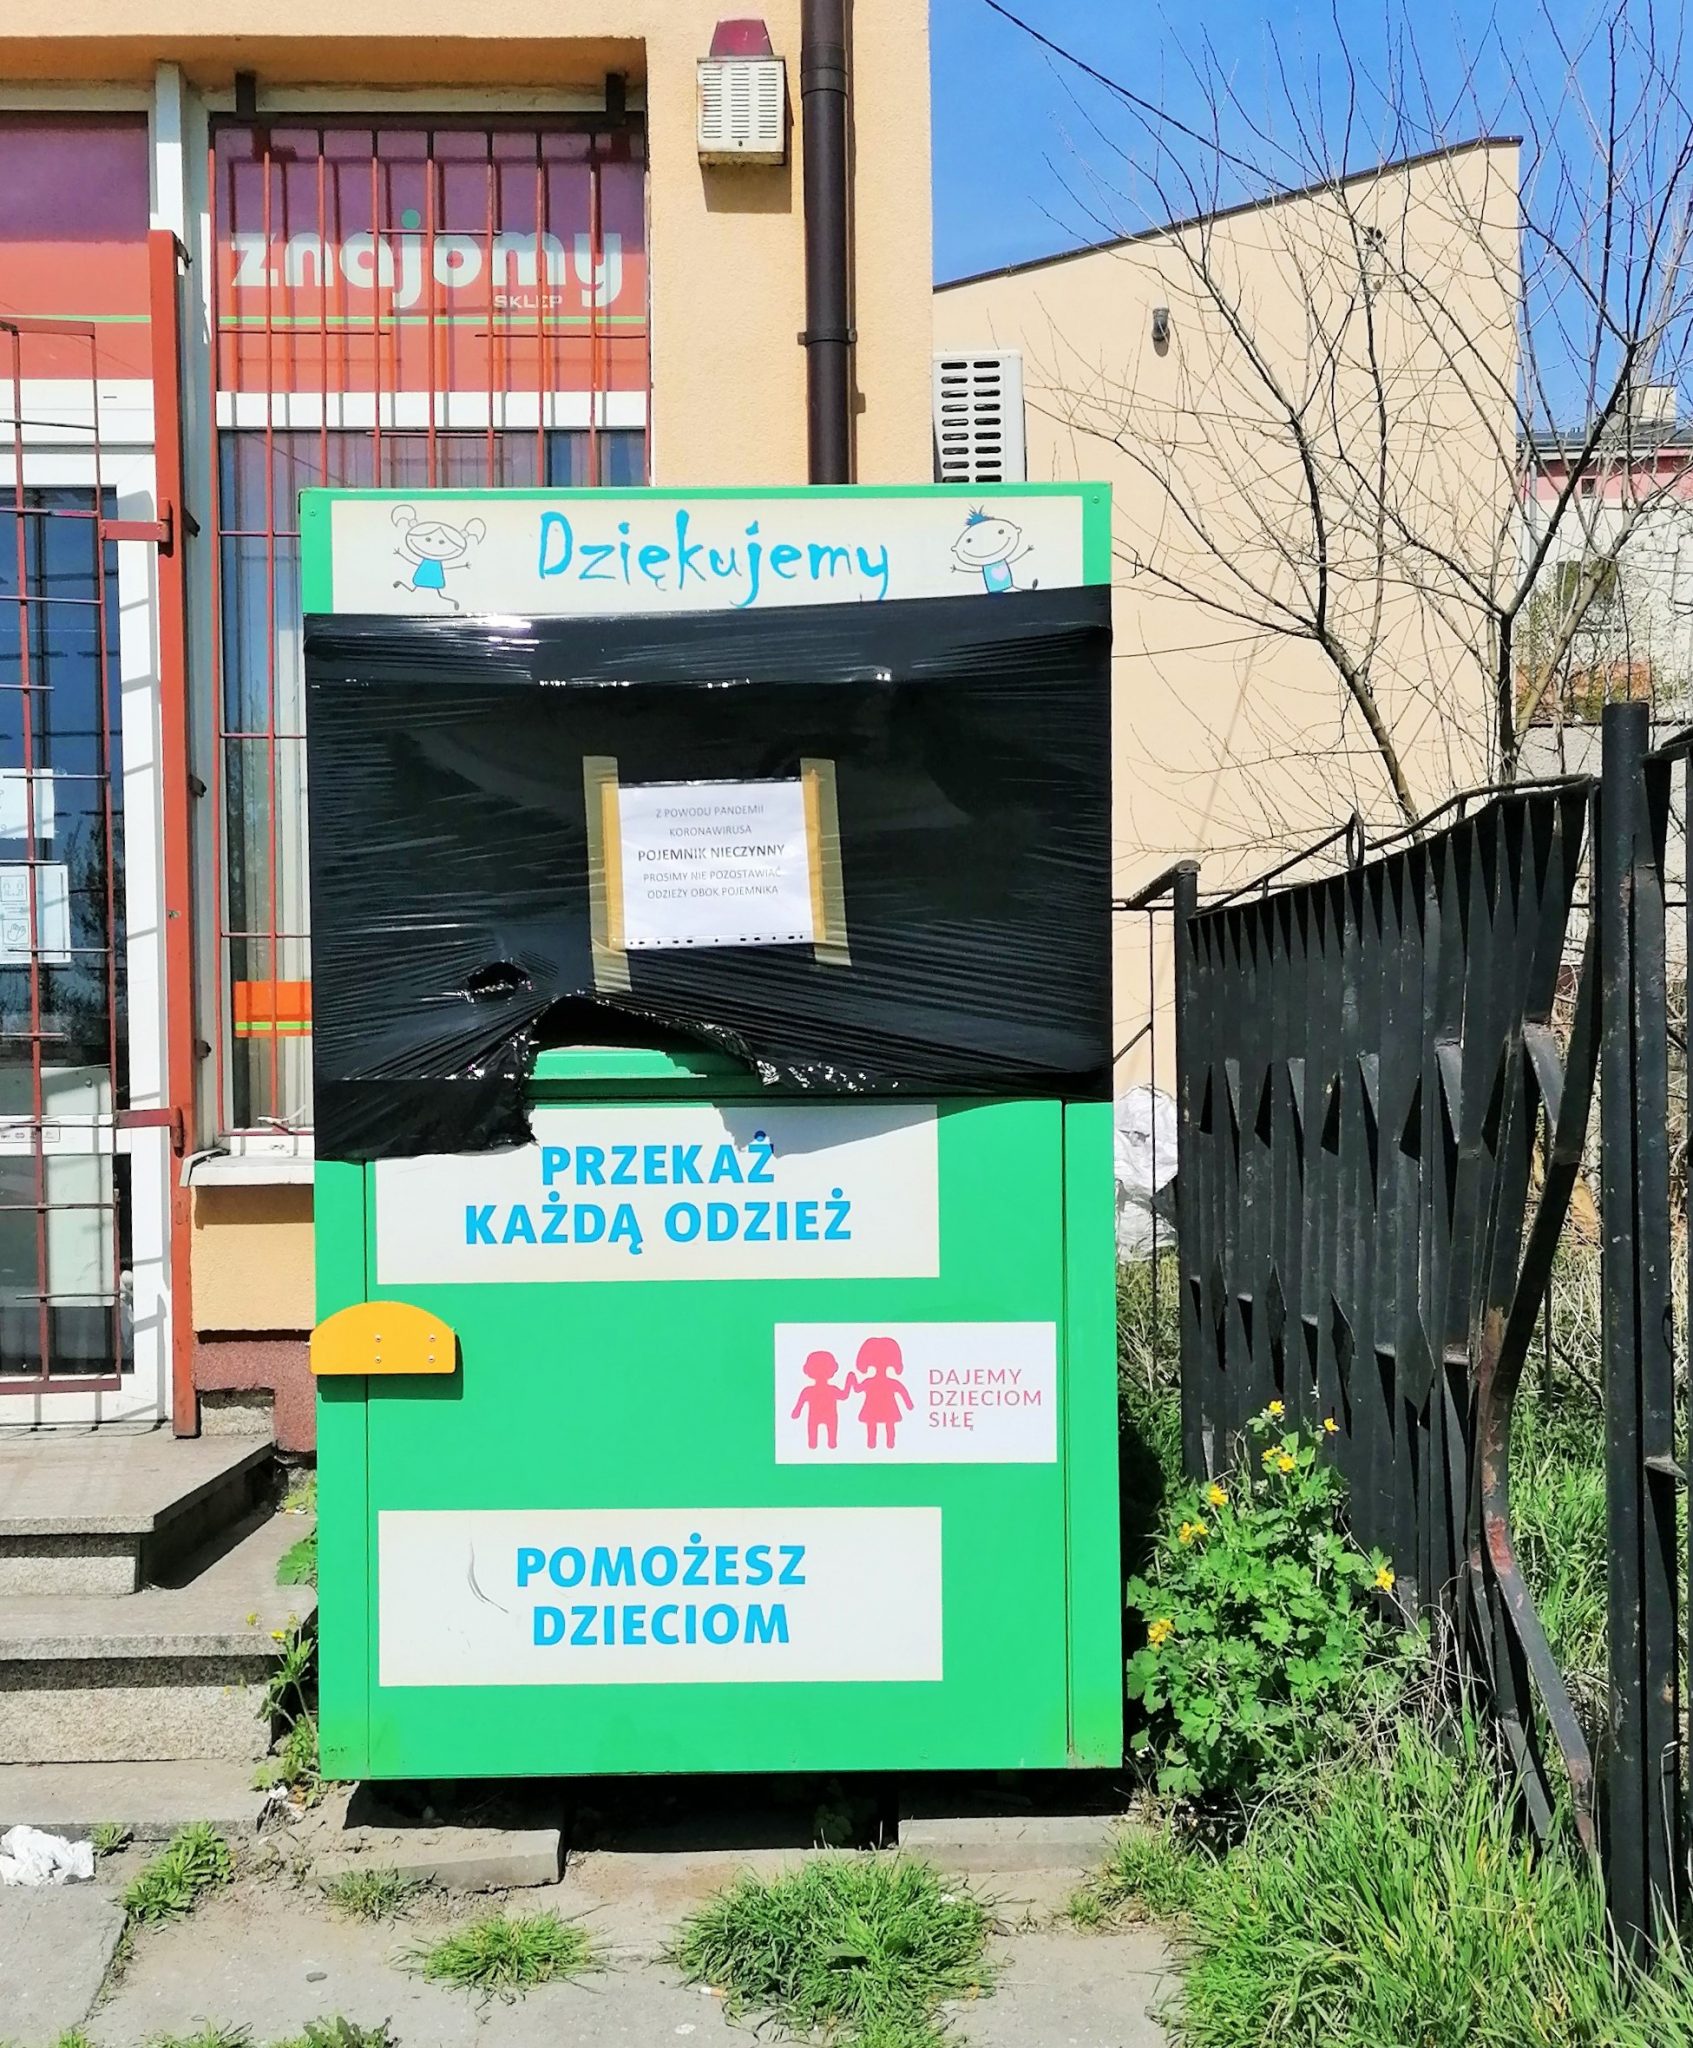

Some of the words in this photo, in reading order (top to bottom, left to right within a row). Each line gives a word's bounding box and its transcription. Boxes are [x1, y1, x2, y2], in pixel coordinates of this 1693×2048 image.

[231, 209, 622, 309] znajomy
[537, 508, 889, 610] Dziękujemy
[656, 809, 662, 818] Z
[664, 807, 711, 818] POWODU
[714, 804, 764, 816] PANDEMII
[669, 825, 752, 837] KORONAWIRUSA
[638, 848, 707, 861] POJEMNIK
[710, 844, 785, 859] NIECZYNNY
[643, 872, 687, 883] PROSIMY
[691, 871, 707, 881] NIE
[691, 887, 720, 898] OBOK
[721, 885, 778, 897] POJEMNIKA
[541, 1130, 775, 1185] PRZEKAŻ
[465, 1191, 644, 1255] KAŻDĄ
[664, 1187, 852, 1243] ODZIEŻ
[928, 1368, 1023, 1385] DAJEMY
[928, 1390, 1042, 1406] DZIECIOM
[928, 1411, 975, 1431] SIŁĘ
[516, 1532, 806, 1587] POMOŻESZ
[532, 1603, 790, 1646] DZIECIOM
